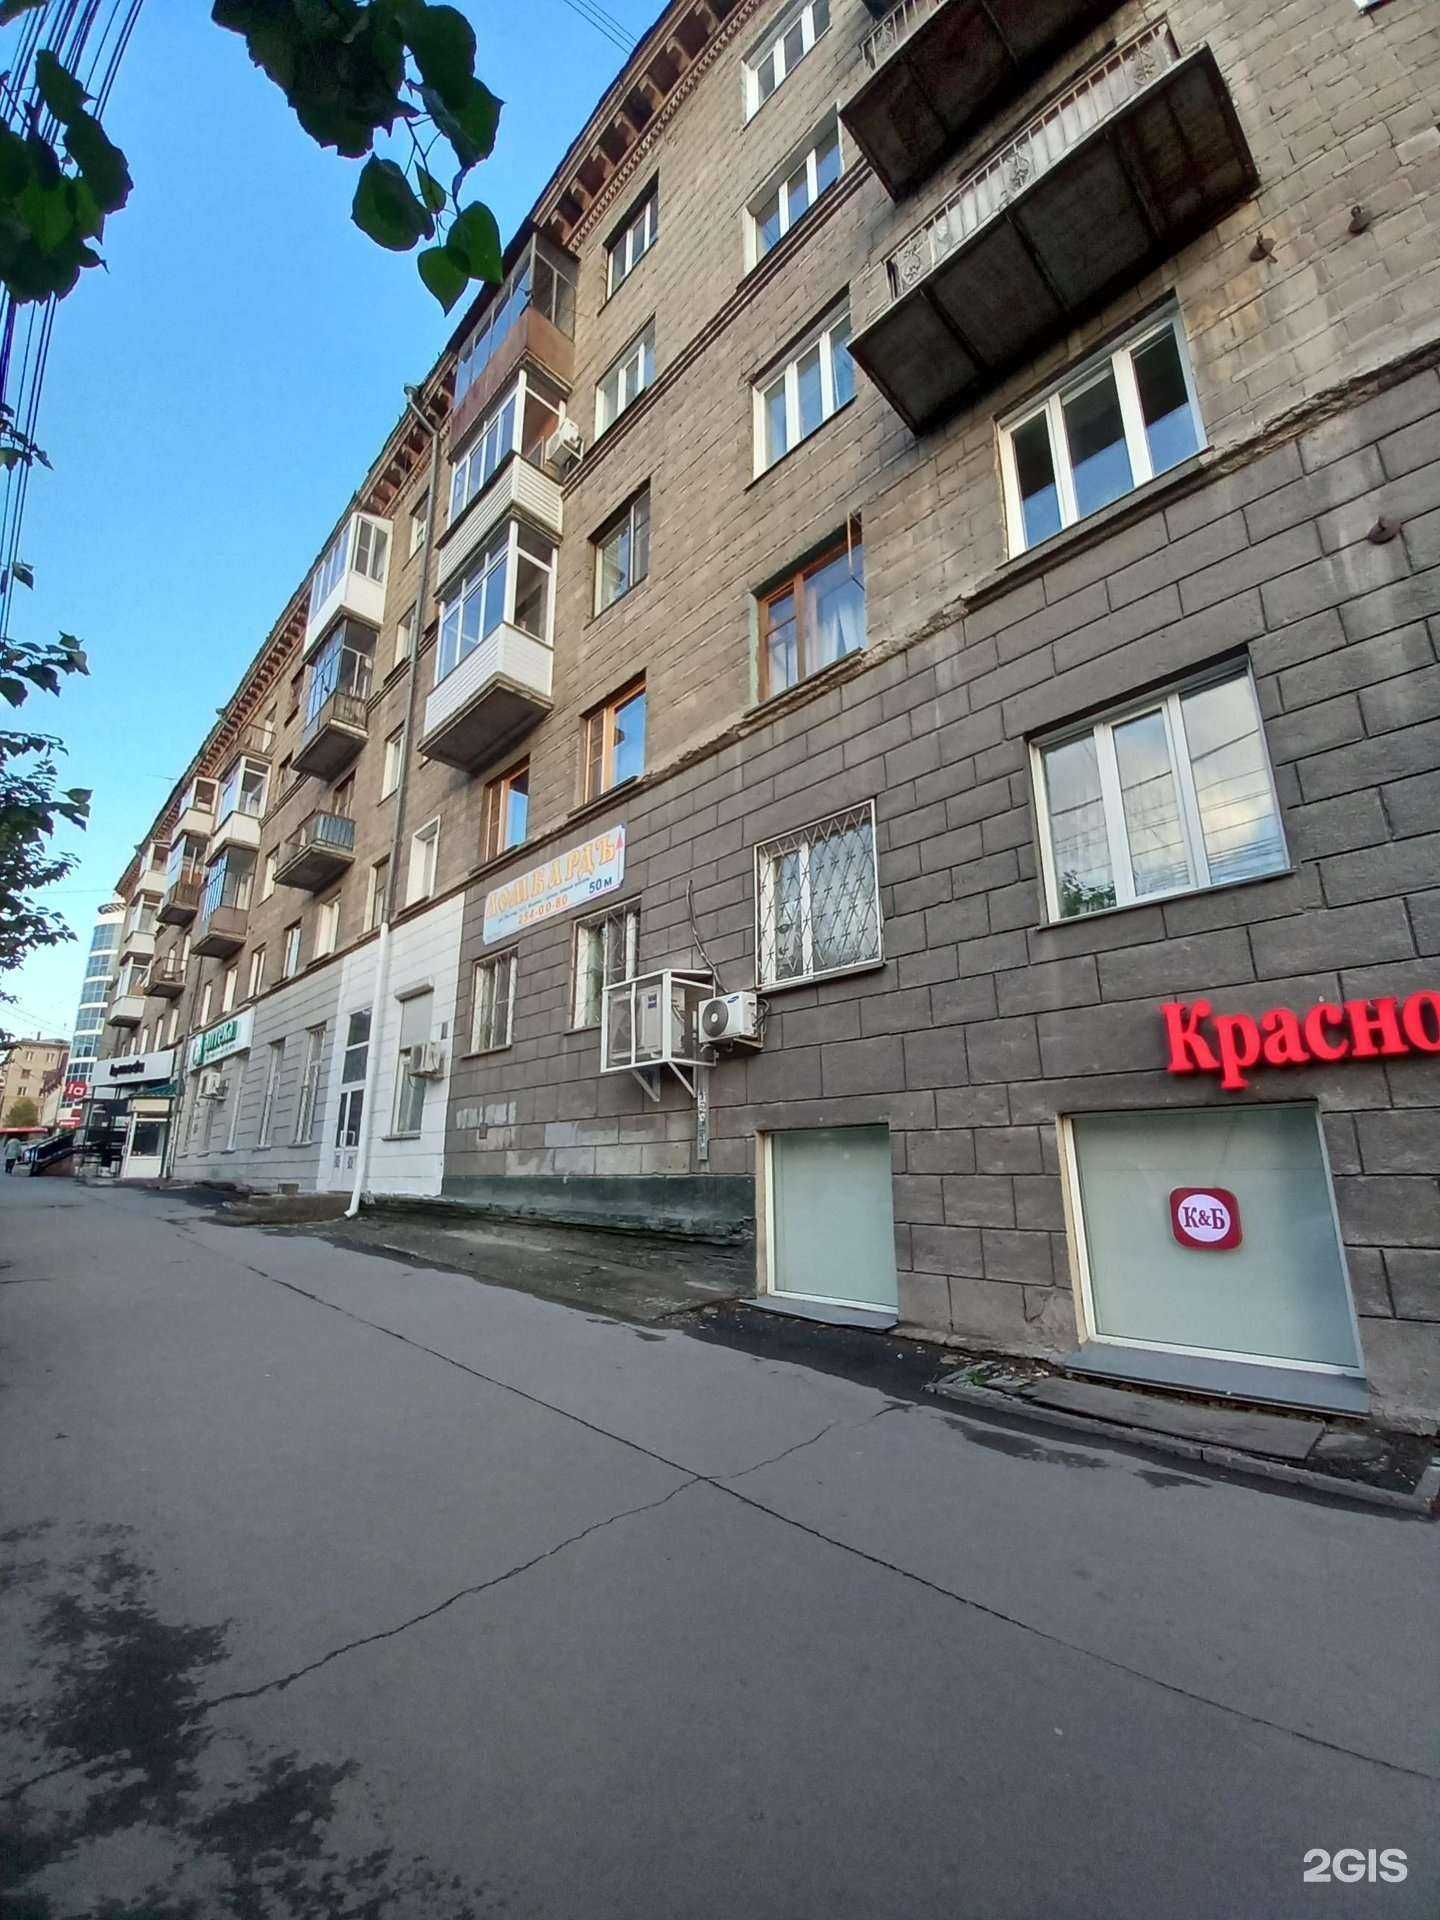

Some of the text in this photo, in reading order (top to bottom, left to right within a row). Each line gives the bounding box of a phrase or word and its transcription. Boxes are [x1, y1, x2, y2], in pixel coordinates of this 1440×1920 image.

[588, 879, 602, 894] 50
[1161, 991, 1440, 1091] Красно
[1182, 1206, 1226, 1230] К&Б
